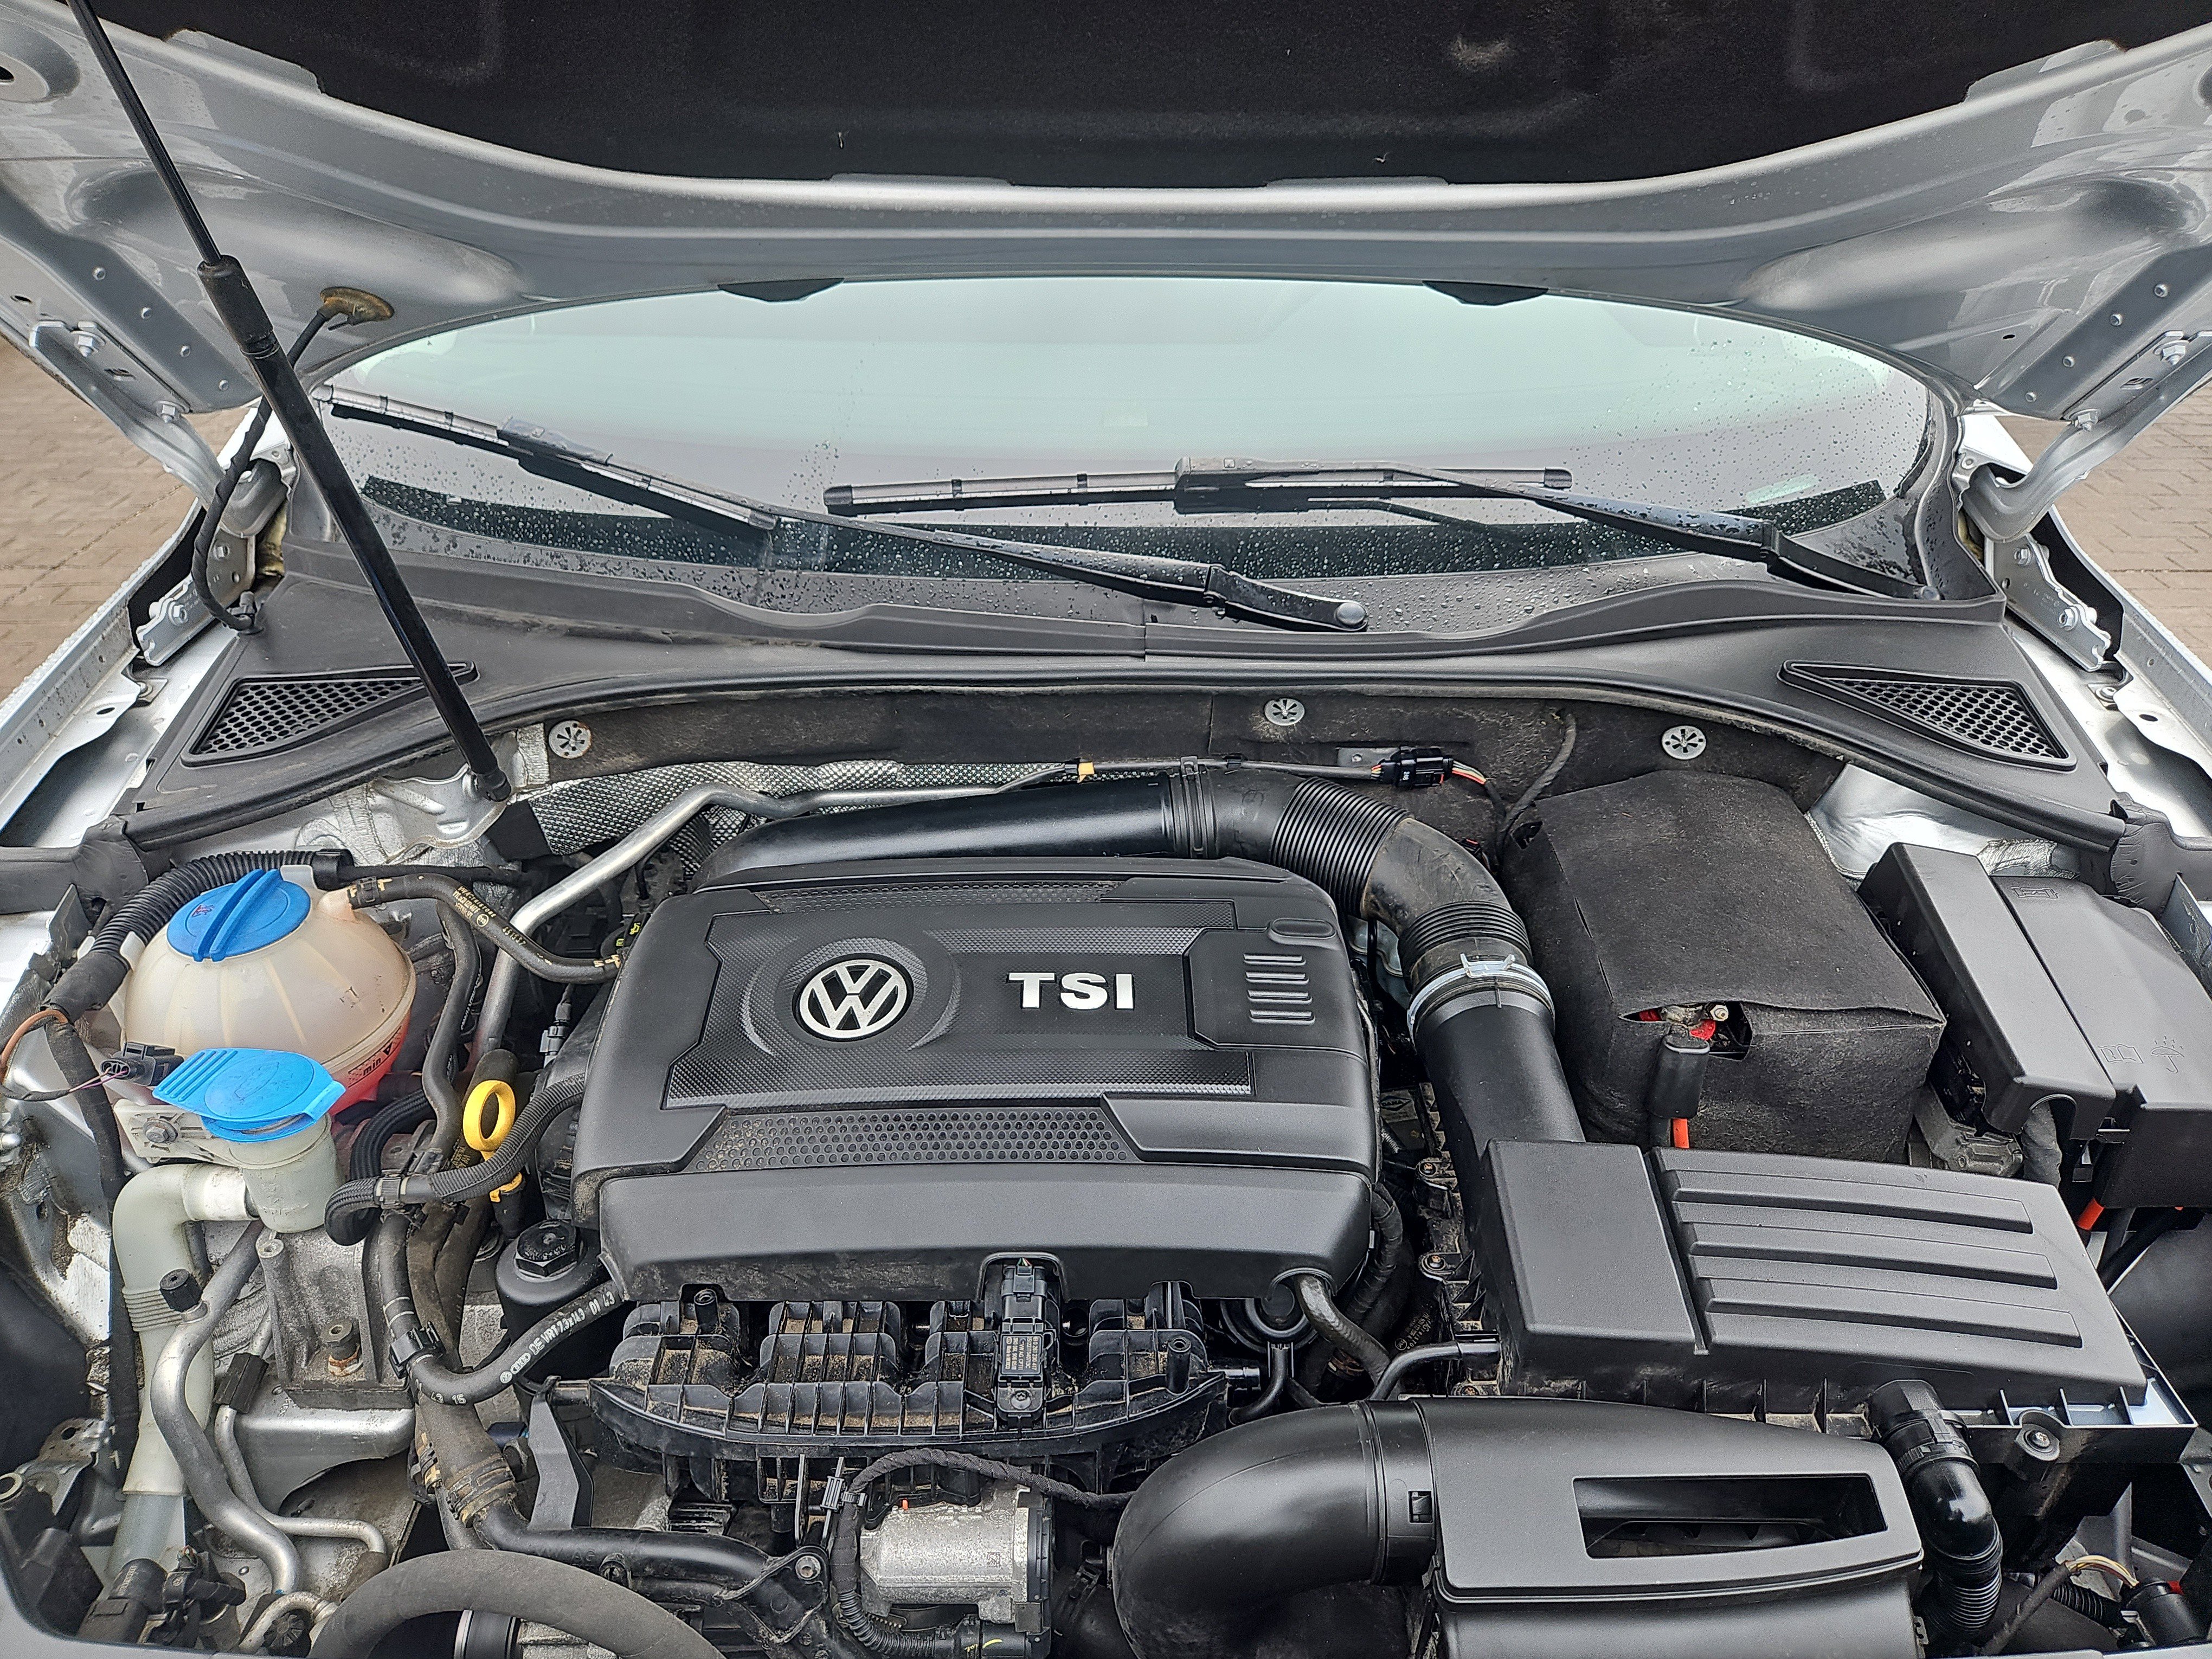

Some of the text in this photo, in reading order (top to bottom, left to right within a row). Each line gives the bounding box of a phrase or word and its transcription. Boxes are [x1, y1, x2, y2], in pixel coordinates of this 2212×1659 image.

[1008, 972, 1134, 1011] TSI
[363, 1058, 382, 1076] min
[541, 1326, 559, 1343] VRT
[452, 1393, 467, 1405] 15
